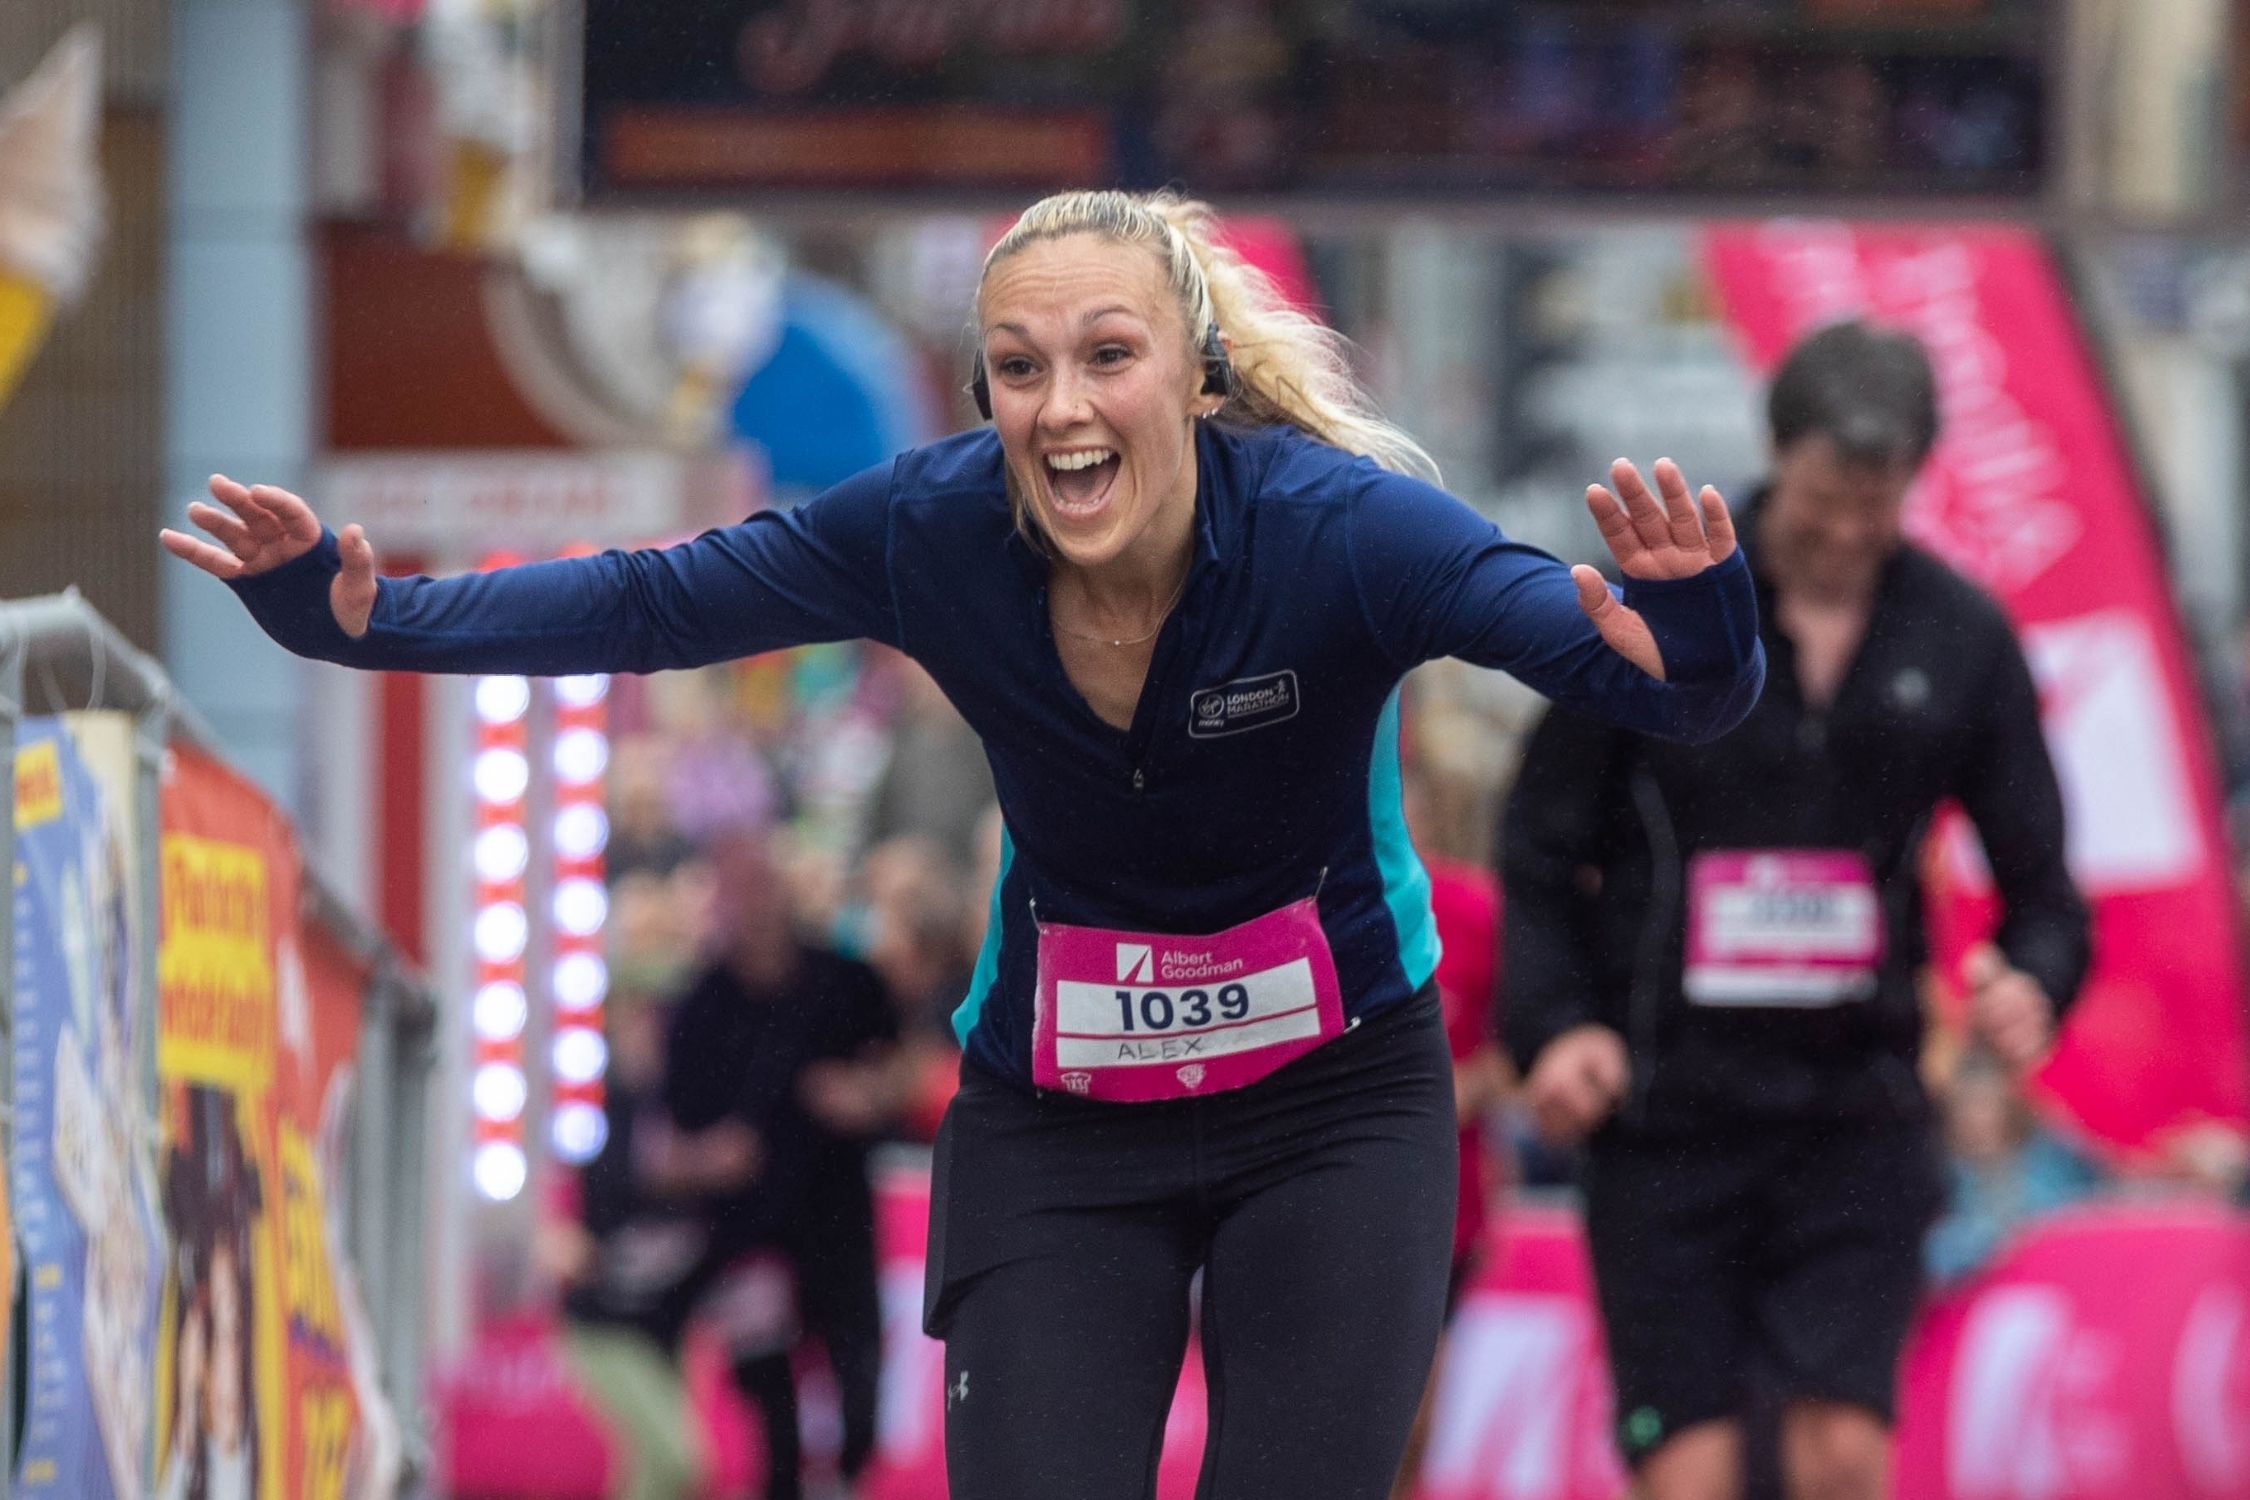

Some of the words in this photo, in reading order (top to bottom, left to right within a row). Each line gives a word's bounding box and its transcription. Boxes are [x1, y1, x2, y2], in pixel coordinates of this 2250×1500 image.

[1227, 688, 1273, 705] LONDON
[1227, 693, 1289, 713] MARATHON
[1160, 950, 1213, 965] Albert
[1161, 958, 1244, 980] Goodman
[1115, 982, 1250, 1032] 1039
[1117, 1036, 1204, 1061] ALEX
